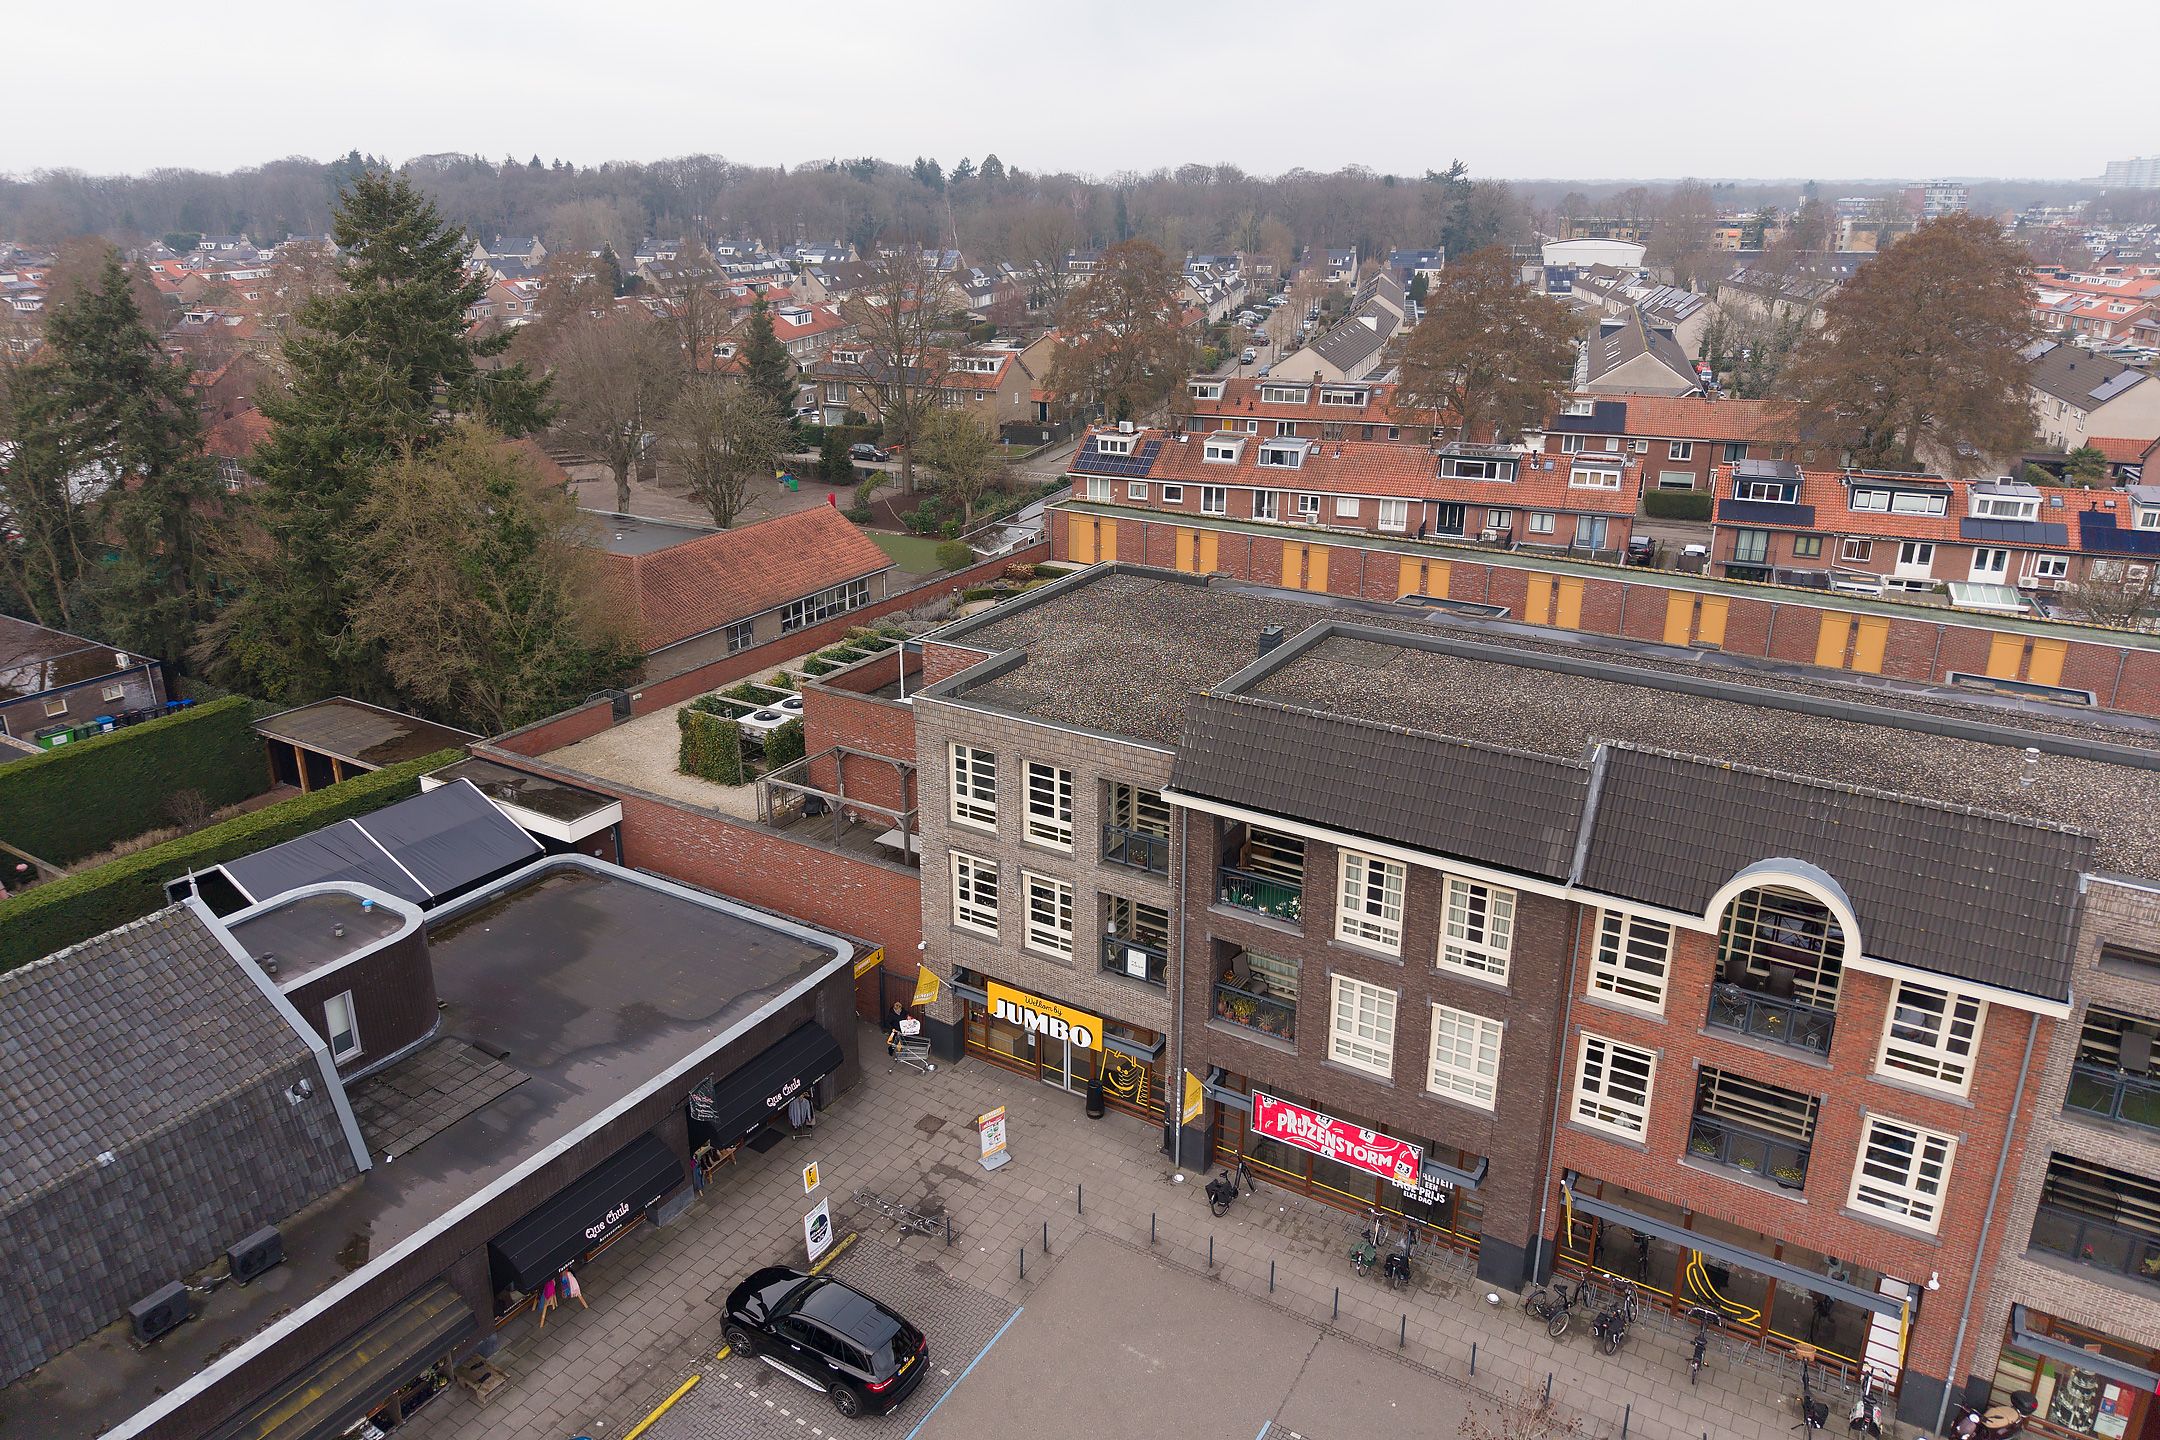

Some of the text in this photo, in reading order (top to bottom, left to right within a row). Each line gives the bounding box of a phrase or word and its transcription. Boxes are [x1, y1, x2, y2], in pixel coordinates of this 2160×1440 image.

[1024, 995, 1054, 1013] Welkom
[993, 998, 1093, 1048] JUMBO
[766, 1093, 783, 1108] Que
[1277, 1108, 1393, 1168] PRIJZENSTORM
[1418, 1186, 1445, 1204] PRIJS
[585, 1221, 606, 1239] Que
